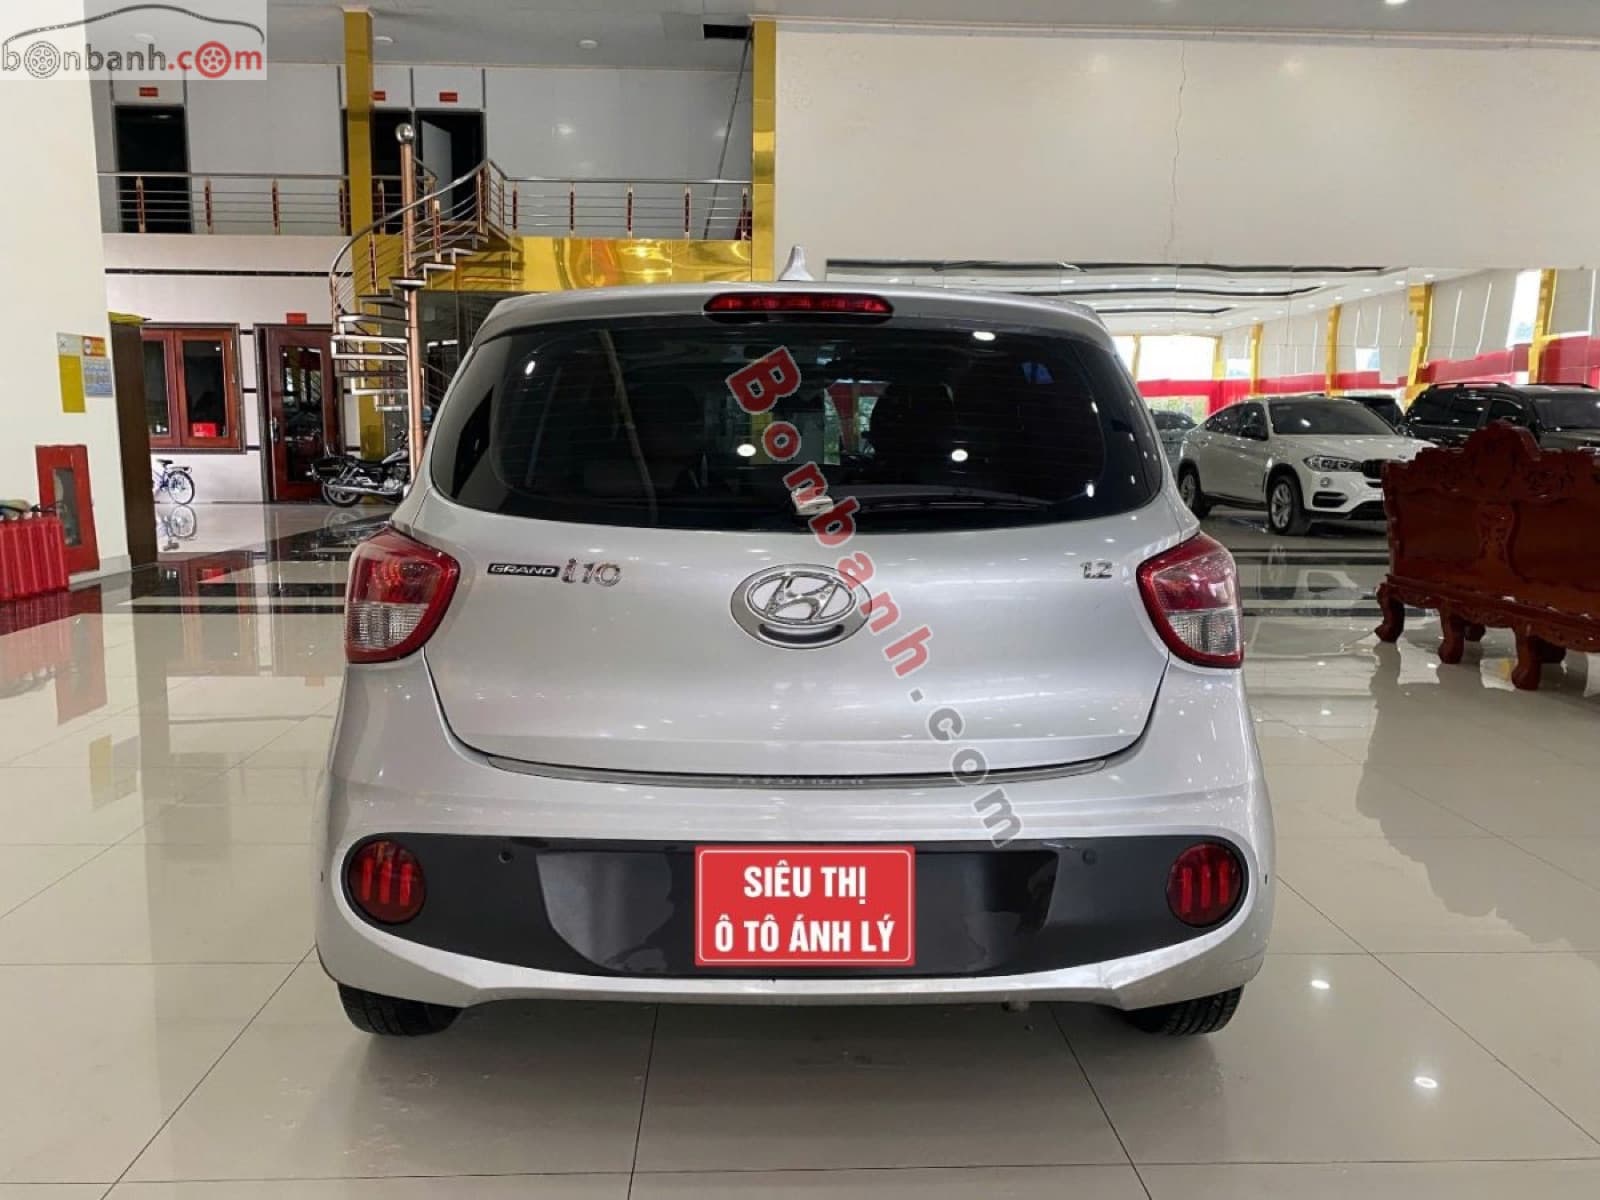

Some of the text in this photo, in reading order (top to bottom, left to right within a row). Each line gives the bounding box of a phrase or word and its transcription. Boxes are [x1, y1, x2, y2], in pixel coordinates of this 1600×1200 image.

[489, 558, 621, 587] GRAND i10
[743, 859, 866, 905] SIÊU THỊ
[714, 913, 896, 953] Ô TÔ ÁNH LÝ
